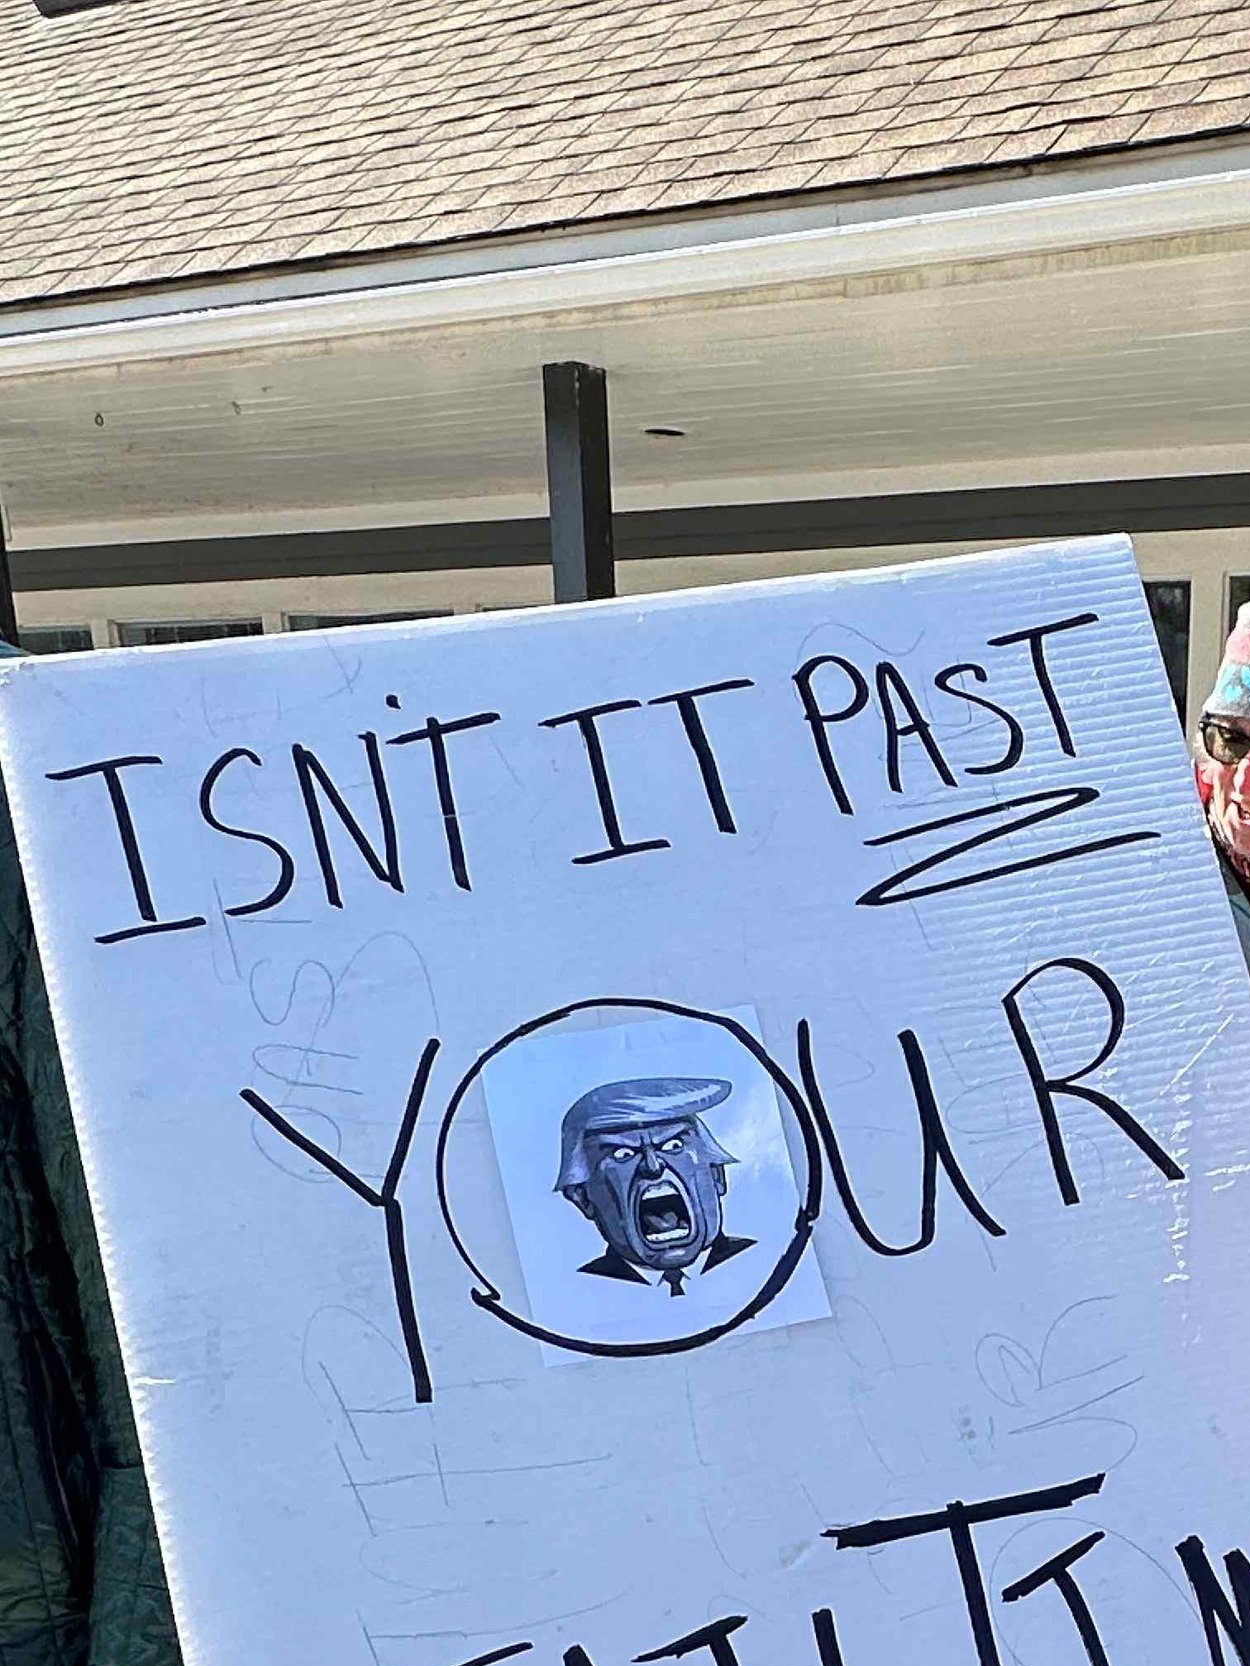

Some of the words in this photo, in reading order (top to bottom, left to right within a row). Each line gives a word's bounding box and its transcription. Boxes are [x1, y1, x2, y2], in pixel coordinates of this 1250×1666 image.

[538, 679, 755, 865] IT
[791, 612, 1100, 816] PAST
[240, 956, 1186, 1405] YOUR
